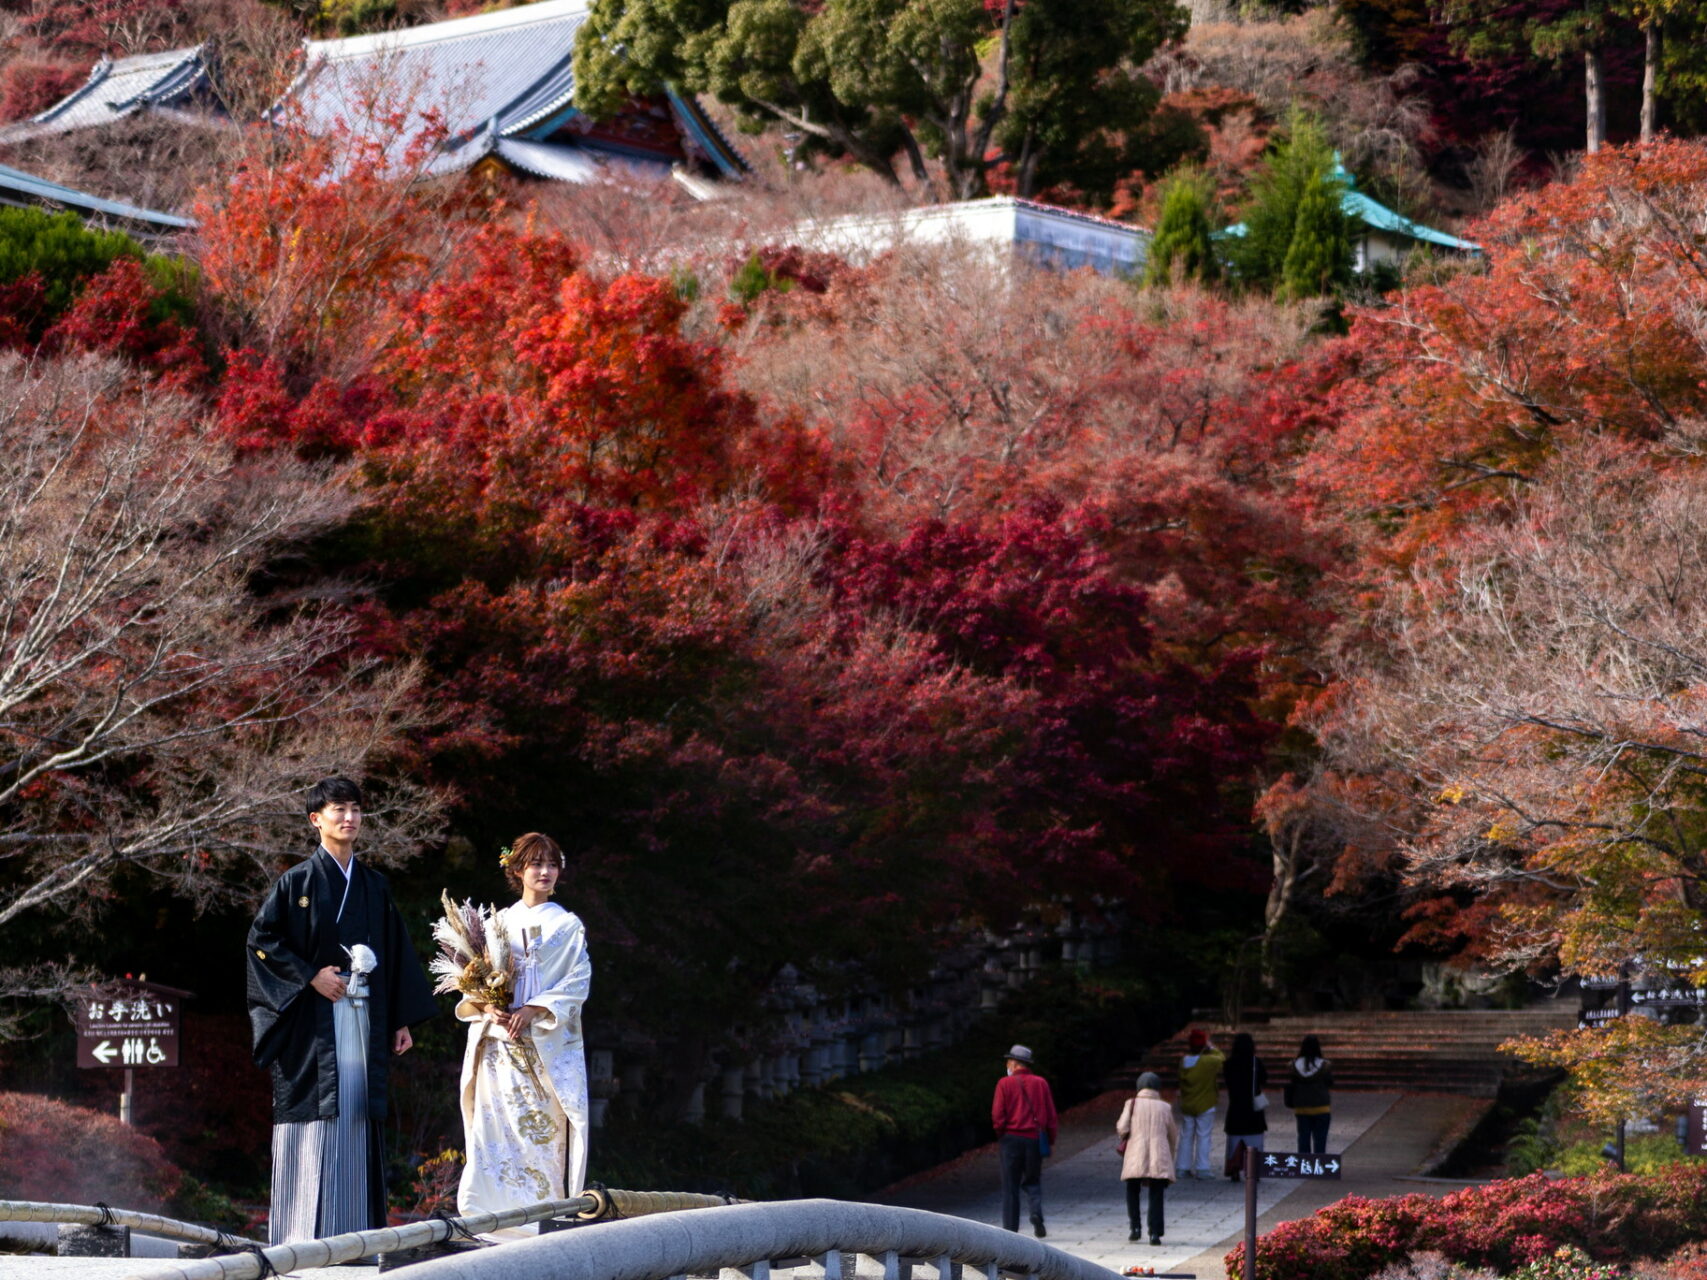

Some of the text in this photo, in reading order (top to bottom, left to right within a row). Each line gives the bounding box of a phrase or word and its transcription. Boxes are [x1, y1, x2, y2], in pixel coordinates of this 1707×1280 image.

[88, 1000, 173, 1021] お手洗い
[1264, 1154, 1298, 1167] 本堂
